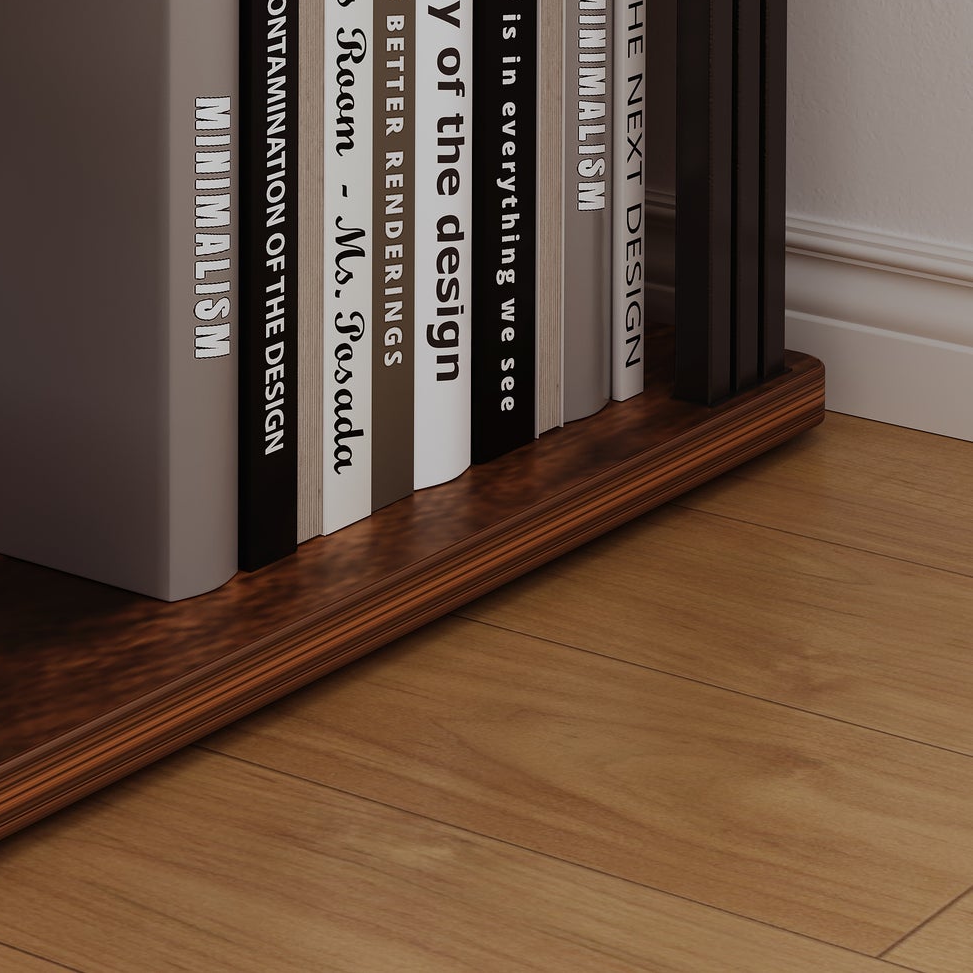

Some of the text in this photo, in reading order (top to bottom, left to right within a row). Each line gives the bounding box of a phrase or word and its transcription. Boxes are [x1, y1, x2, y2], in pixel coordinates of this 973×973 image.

[385, 14, 405, 136] BETTER
[436, 47, 466, 98] of
[502, 13, 521, 40] is
[502, 56, 521, 85] in
[335, 27, 367, 157] Room
[626, 72, 644, 186] NEXT
[436, 112, 466, 196] the
[496, 101, 520, 286] everything
[194, 96, 231, 359] MINIMALISM
[265, 232, 286, 272] OF
[334, 215, 366, 299] Ms.
[383, 151, 404, 367] RENDERINGS
[265, 274, 285, 339] THE
[426, 214, 465, 382] design
[501, 297, 515, 342] we
[625, 203, 643, 369] DESIGN
[264, 341, 285, 456] DESIGN
[333, 310, 365, 475] Posada
[500, 357, 515, 412] see
